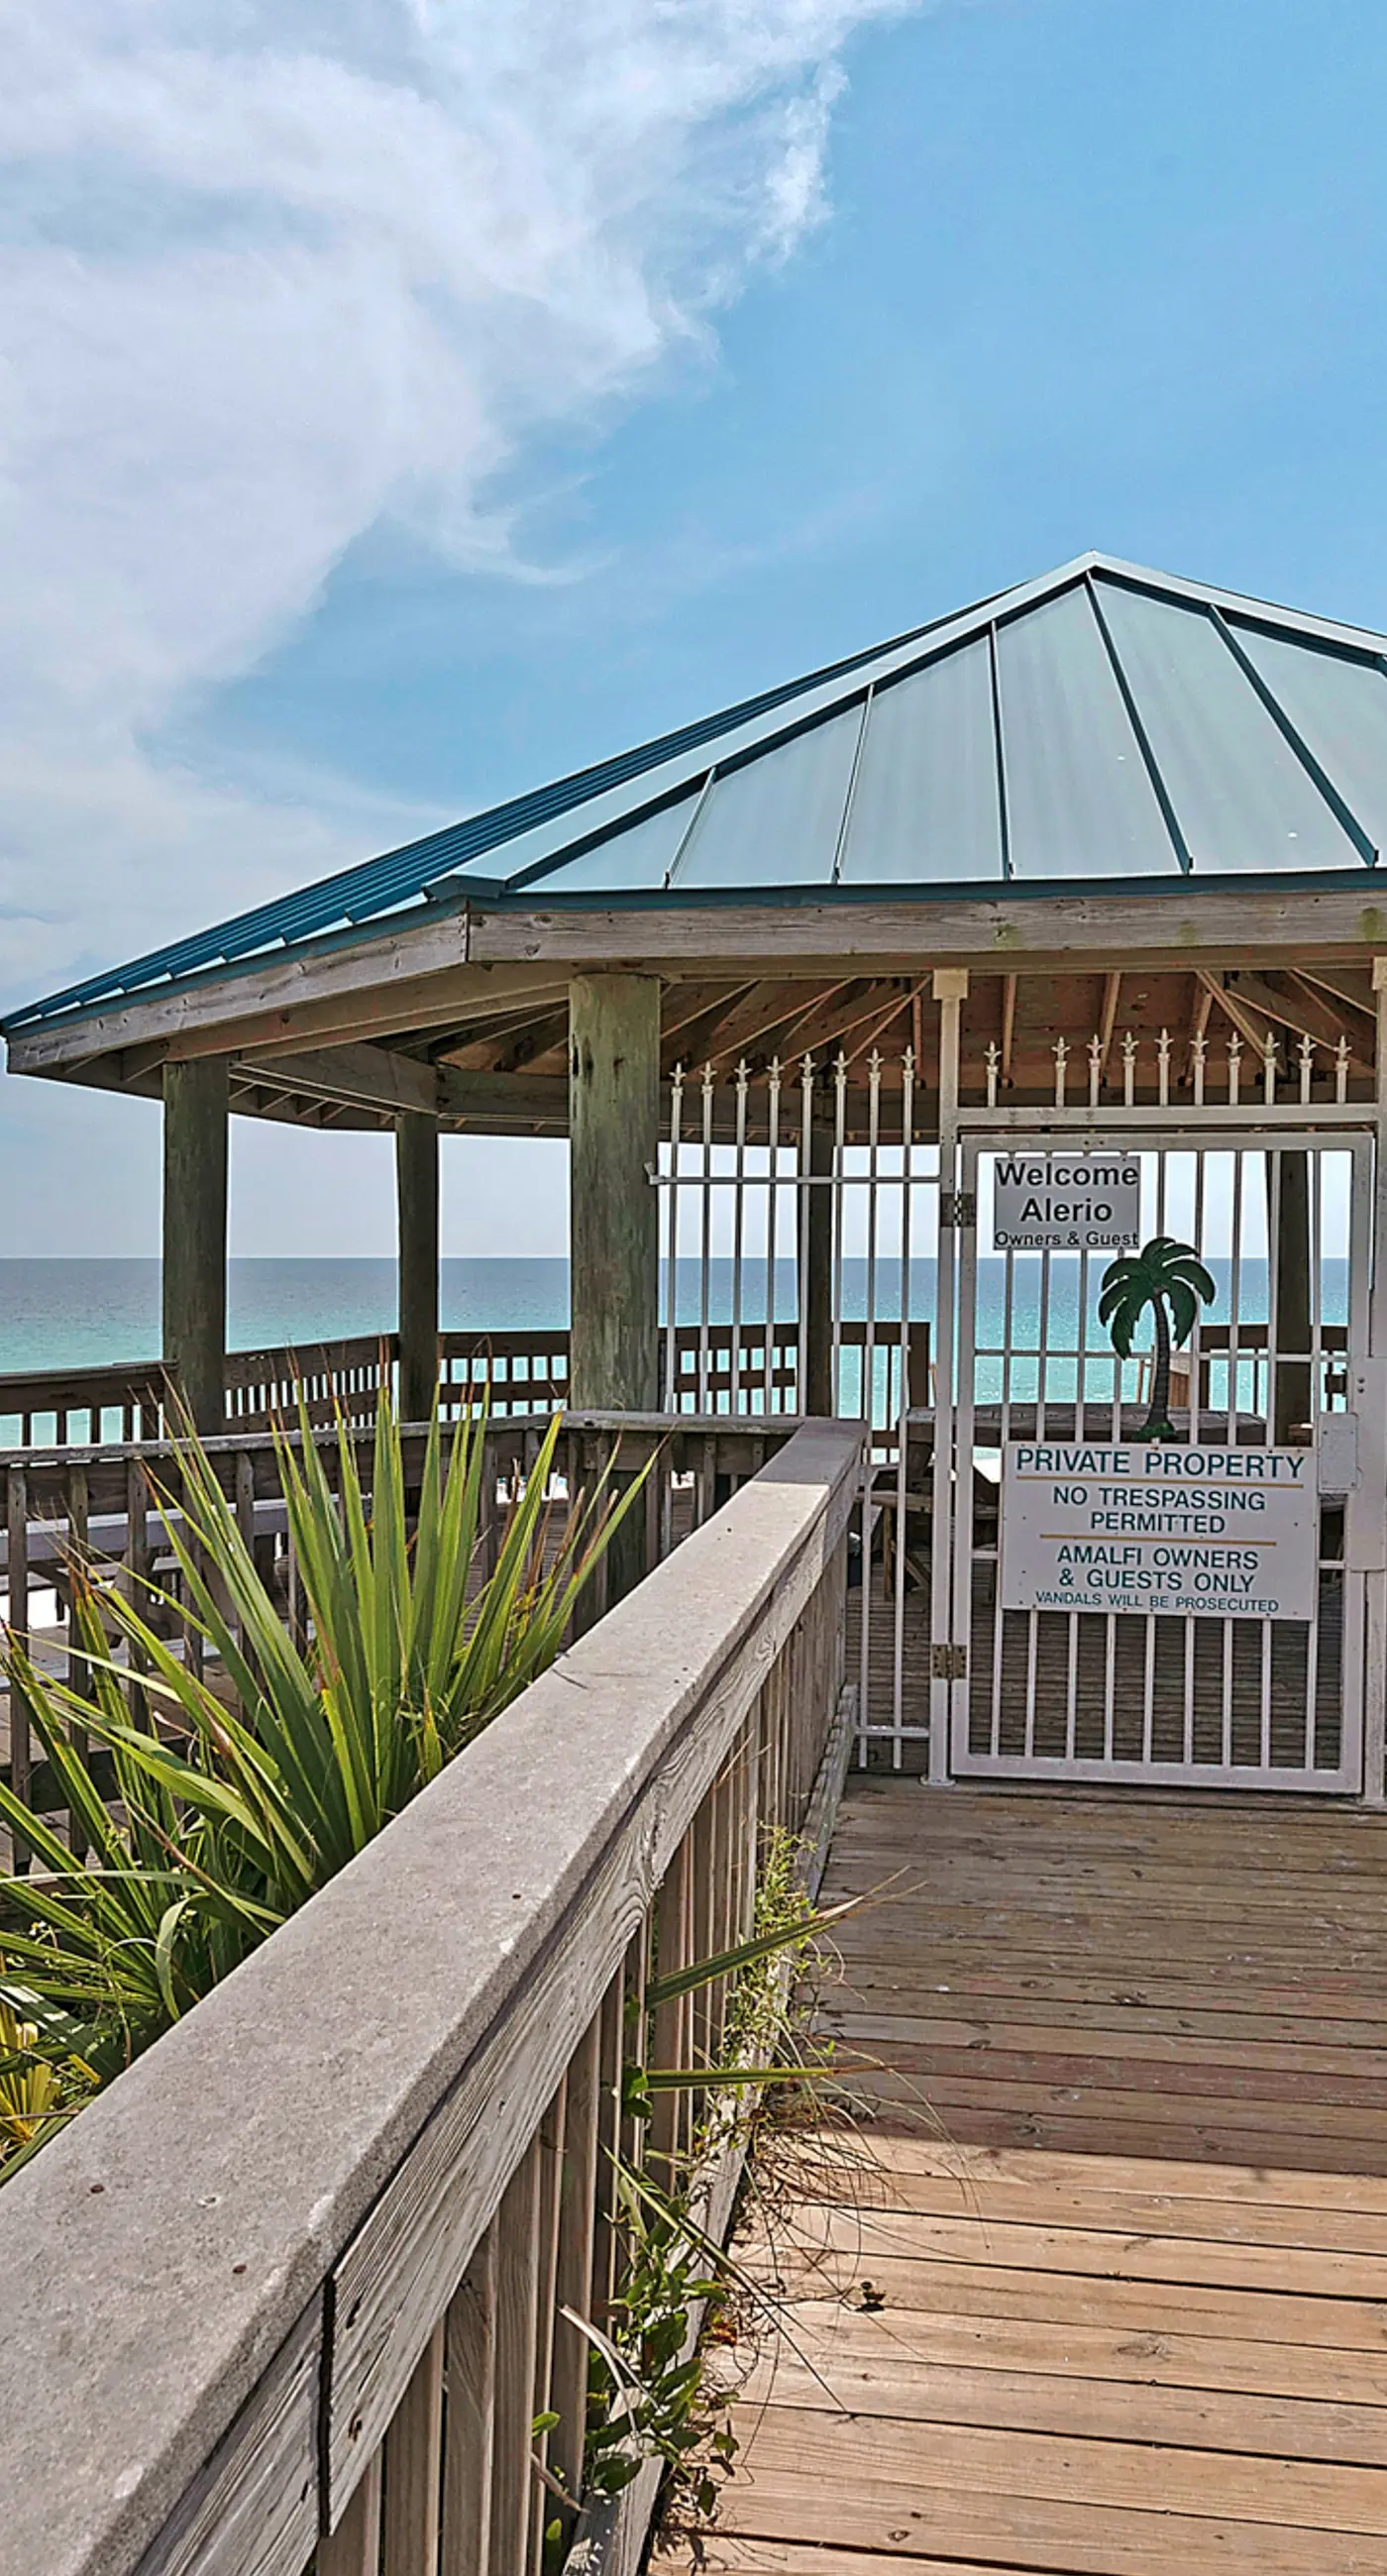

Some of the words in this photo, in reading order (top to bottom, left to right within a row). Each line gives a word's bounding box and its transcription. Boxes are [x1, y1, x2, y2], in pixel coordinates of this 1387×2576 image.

[996, 1162, 1138, 1186] Welcome
[1019, 1198, 1113, 1222] Alerio
[995, 1232, 1061, 1245] Owners
[1067, 1231, 1080, 1245] &
[1086, 1231, 1138, 1245] Guest
[1016, 1449, 1130, 1473] PRIVATE
[1145, 1451, 1305, 1478] PROPERTY
[1053, 1486, 1088, 1506] NO
[1099, 1487, 1266, 1511] TRESPASSING
[1091, 1512, 1226, 1534] PERMITTED
[1057, 1546, 1141, 1565] AMALFI
[1153, 1548, 1259, 1570] OWNERS
[1059, 1568, 1074, 1587] &
[1087, 1569, 1182, 1591] GUESTS
[1194, 1572, 1255, 1593] ONLY
[1035, 1591, 1102, 1606] VANDALS
[1109, 1593, 1143, 1607] WILL
[1150, 1595, 1169, 1608] BE
[1176, 1596, 1279, 1613] PROSECUTED
